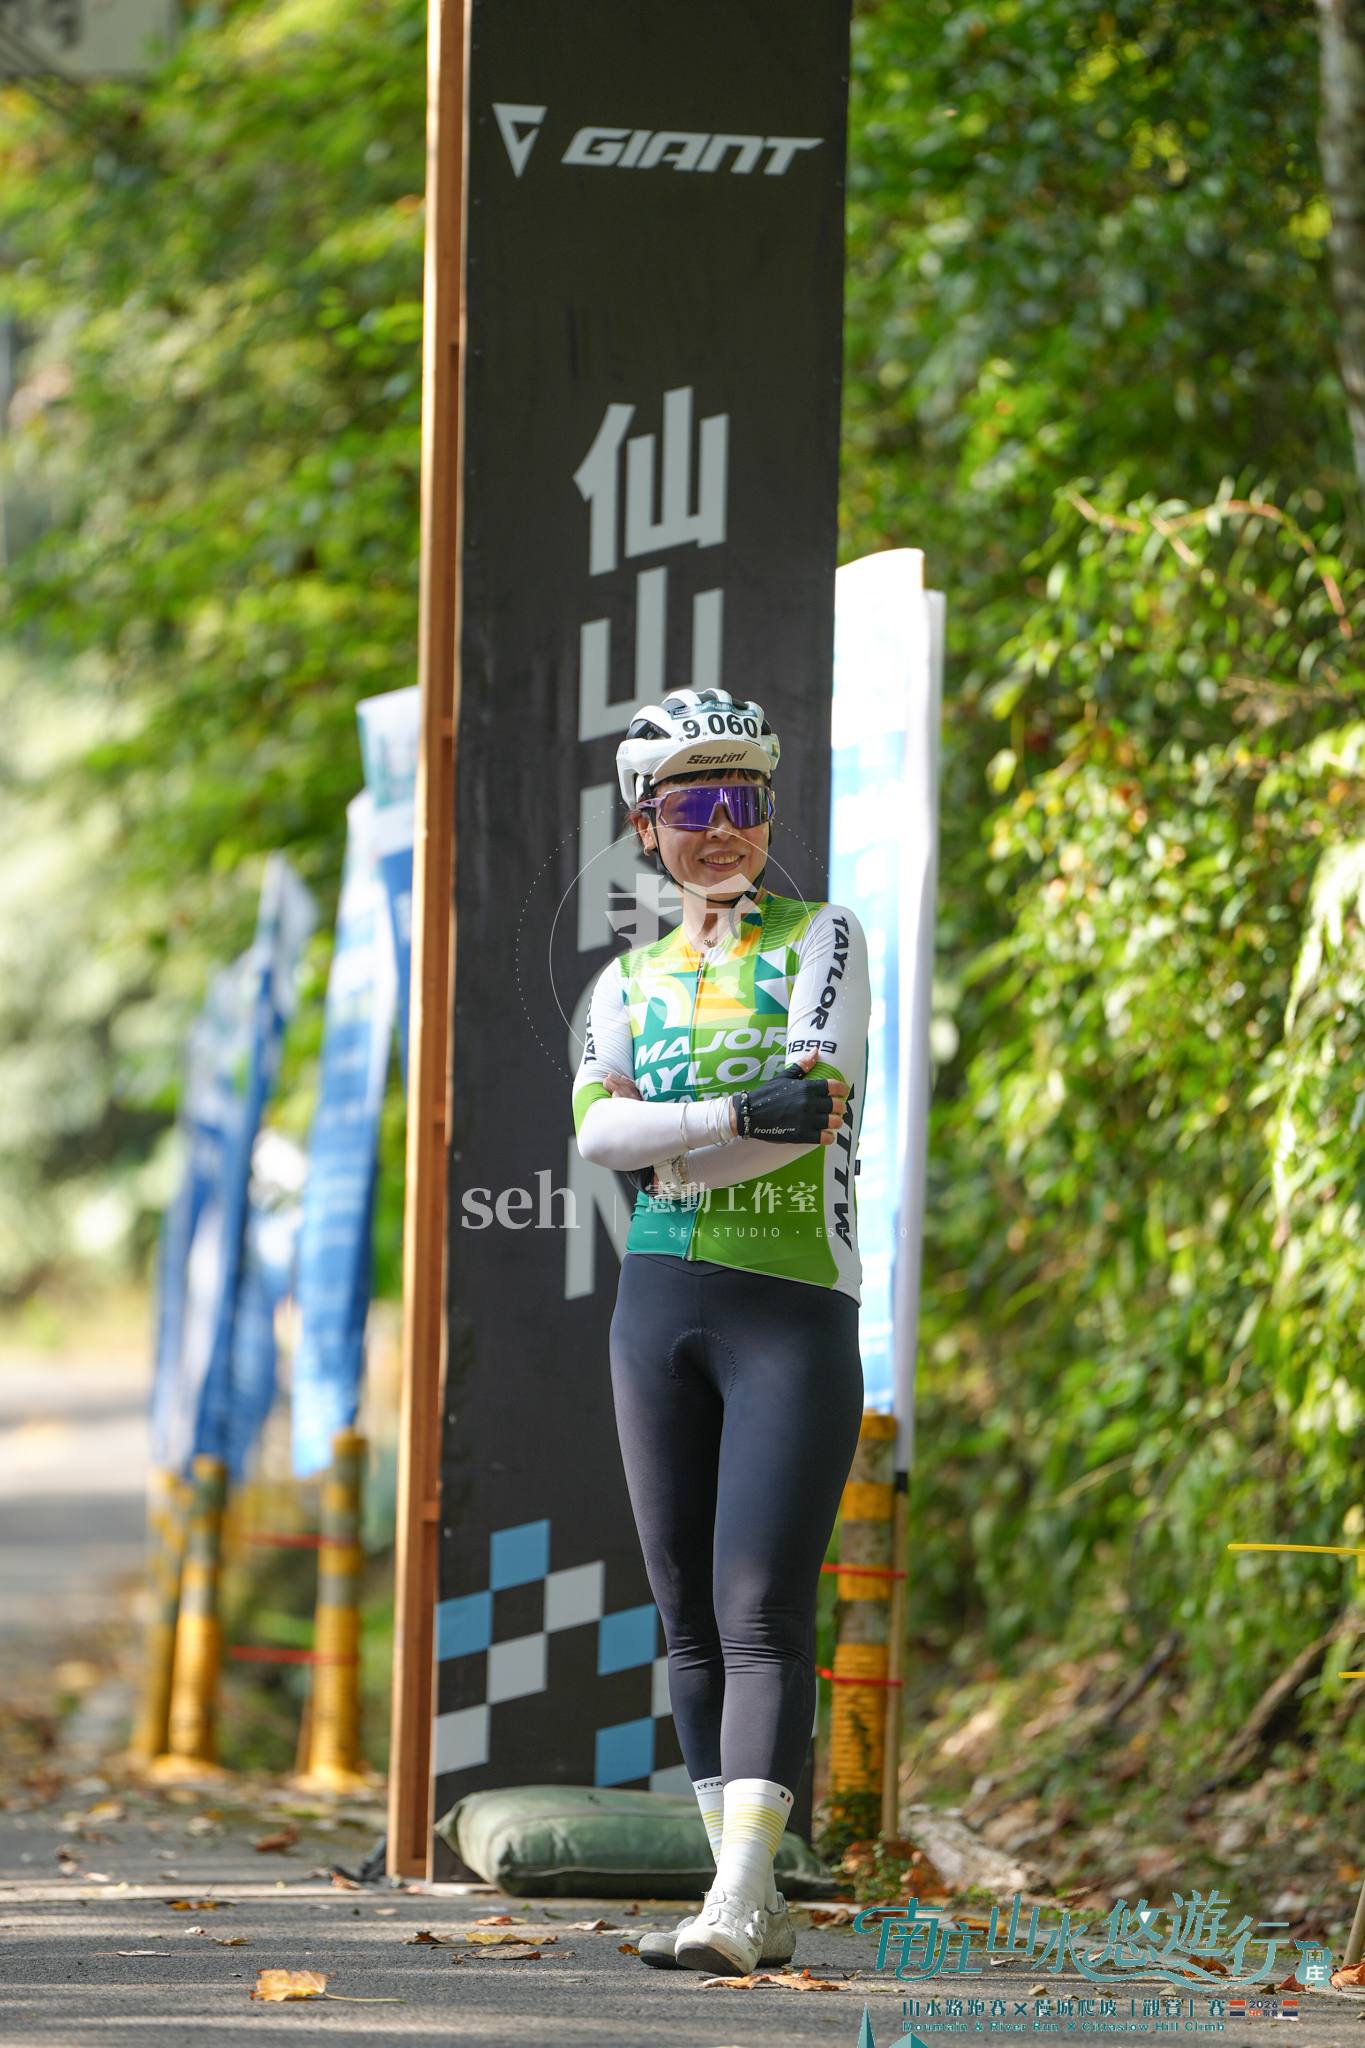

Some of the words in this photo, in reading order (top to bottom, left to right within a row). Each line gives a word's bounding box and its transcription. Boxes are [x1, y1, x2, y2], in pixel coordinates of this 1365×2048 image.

[561, 127, 826, 176] GIANT
[687, 751, 748, 765] Santini
[809, 915, 851, 1030] TAYLOR
[634, 1026, 786, 1071] MAJOR
[787, 1039, 838, 1055] 1899
